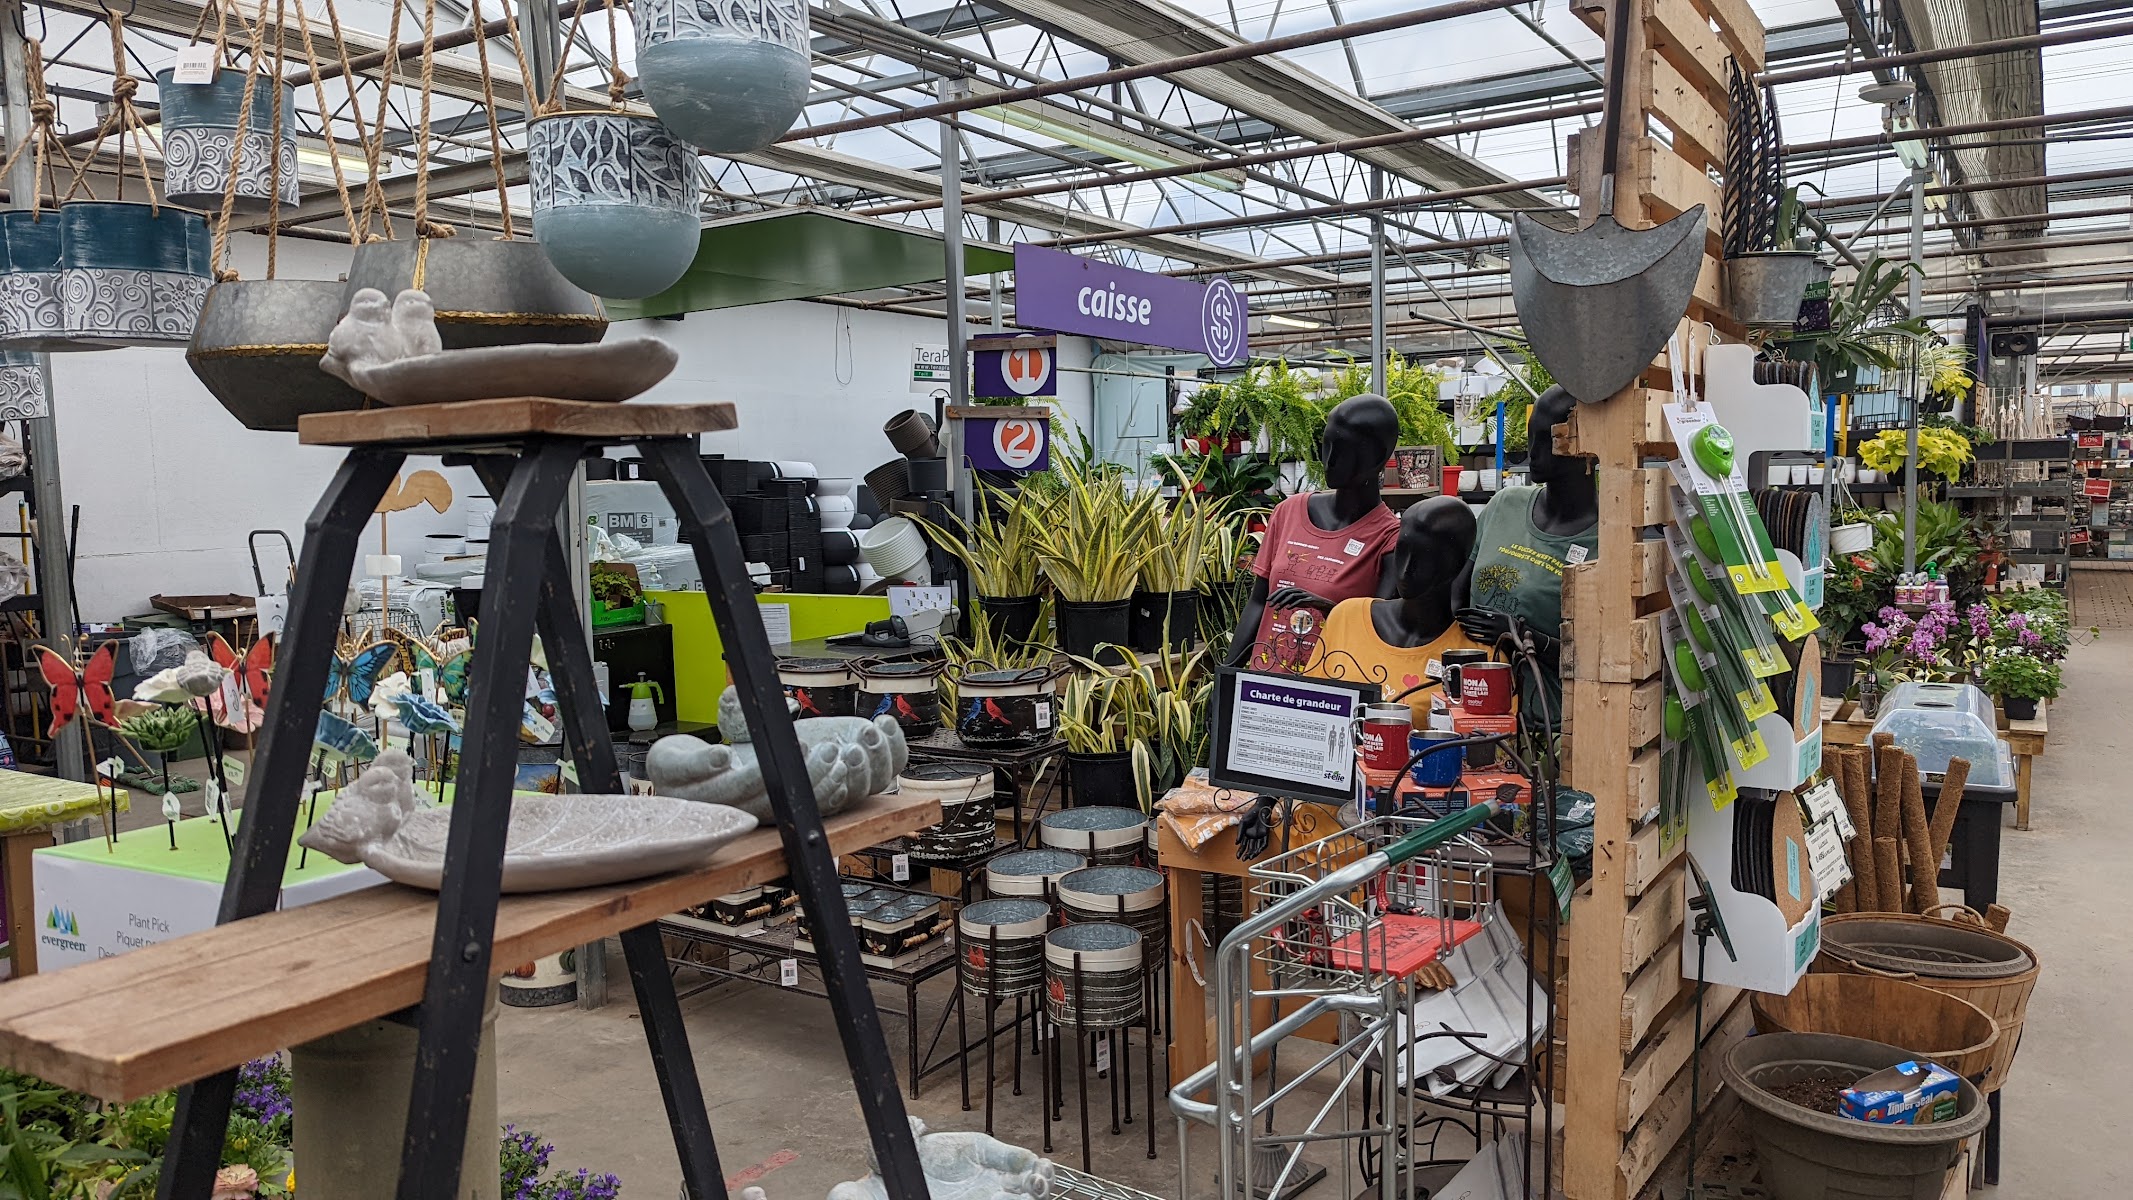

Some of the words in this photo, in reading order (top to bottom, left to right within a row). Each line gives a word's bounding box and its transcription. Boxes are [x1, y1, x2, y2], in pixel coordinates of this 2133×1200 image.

[1077, 281, 1151, 326] caisse
[1013, 348, 1035, 383] 1
[1007, 418, 1030, 453] 2
[609, 514, 634, 528] BM
[641, 514, 648, 524] 6
[1250, 689, 1281, 702] Charte
[1282, 694, 1295, 704] de
[1296, 698, 1341, 711] grandeur
[128, 912, 150, 928] Plant
[151, 917, 170, 933] Pick
[41, 933, 86, 952] evergreen
[116, 931, 144, 949] Piquet
[1887, 1100, 1912, 1116] Zipper
